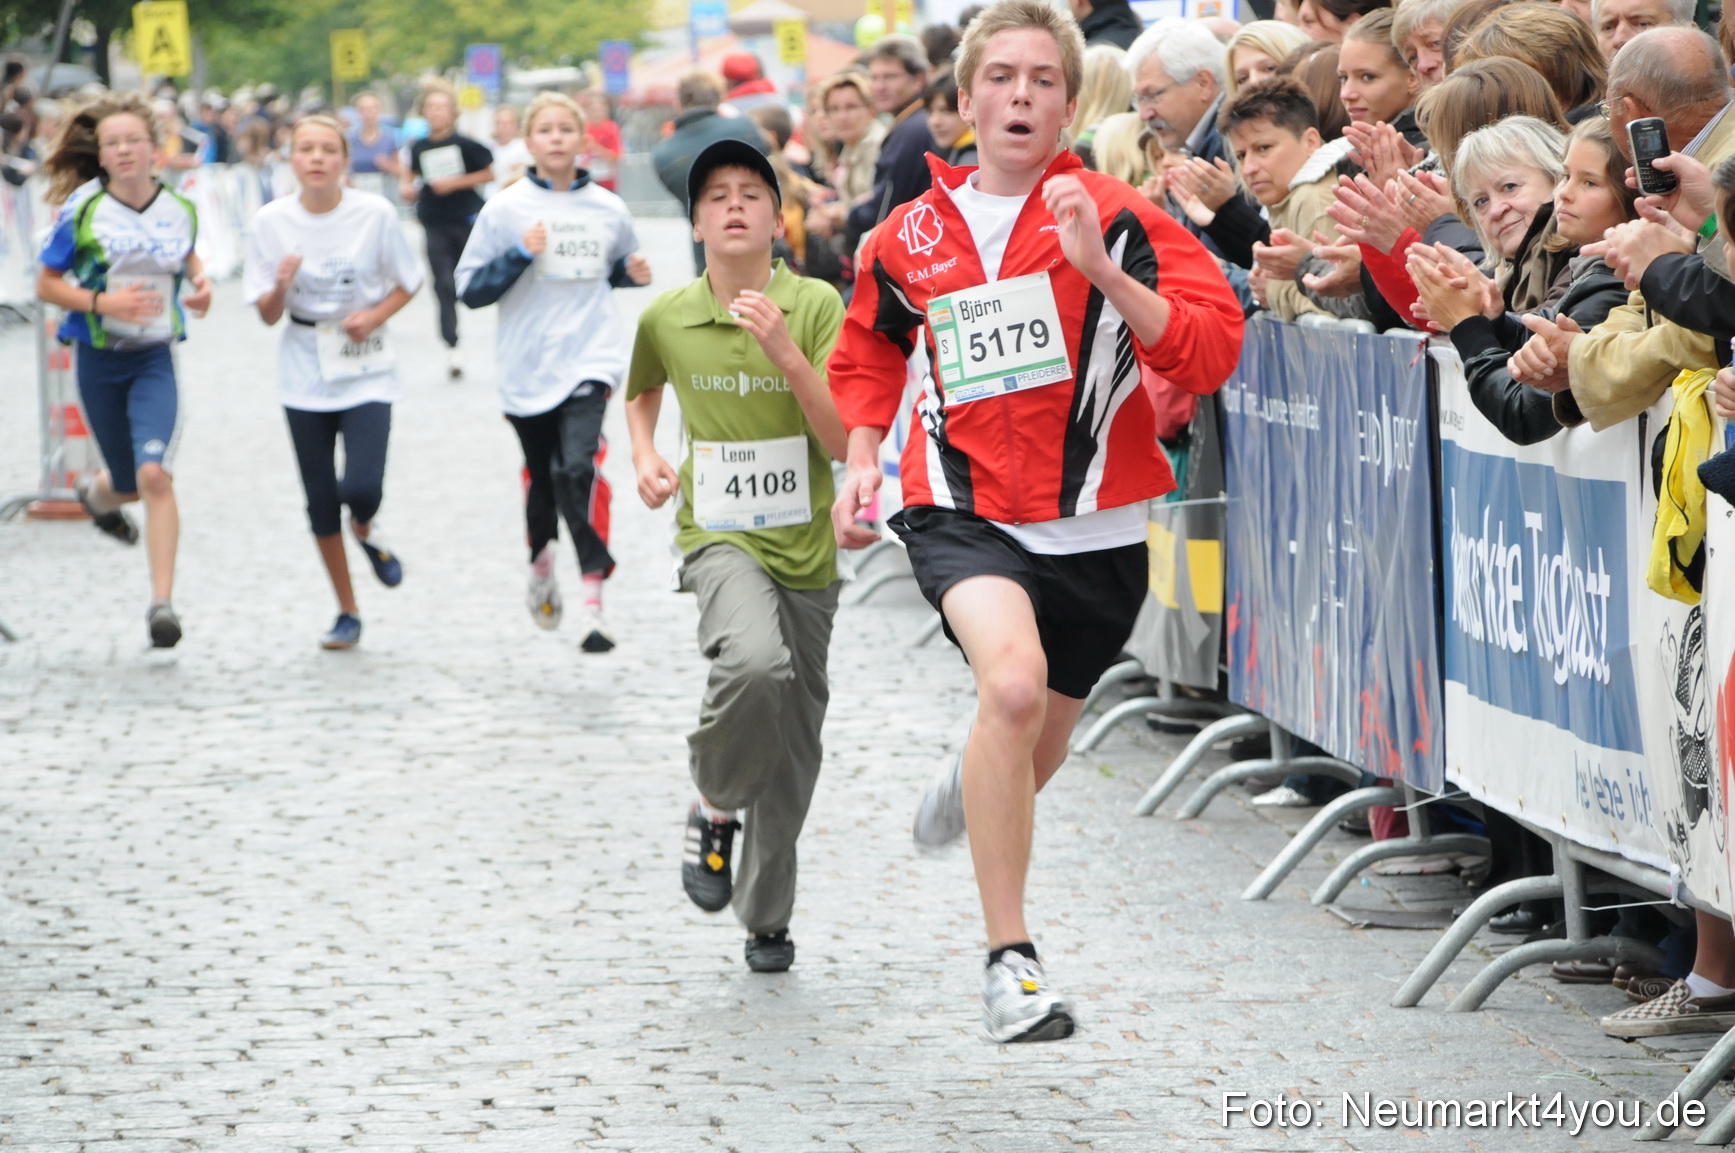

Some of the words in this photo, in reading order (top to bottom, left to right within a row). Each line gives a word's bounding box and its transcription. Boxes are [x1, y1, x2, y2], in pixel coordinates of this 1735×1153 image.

[149, 23, 178, 58] A
[554, 241, 599, 257] 4052
[959, 299, 1003, 323] Björn
[941, 339, 949, 354] S
[969, 318, 1050, 363] 5179
[1017, 364, 1068, 382] PFLEIDERER
[721, 445, 756, 463] Leon
[698, 473, 705, 486] J
[724, 469, 798, 499] 4108
